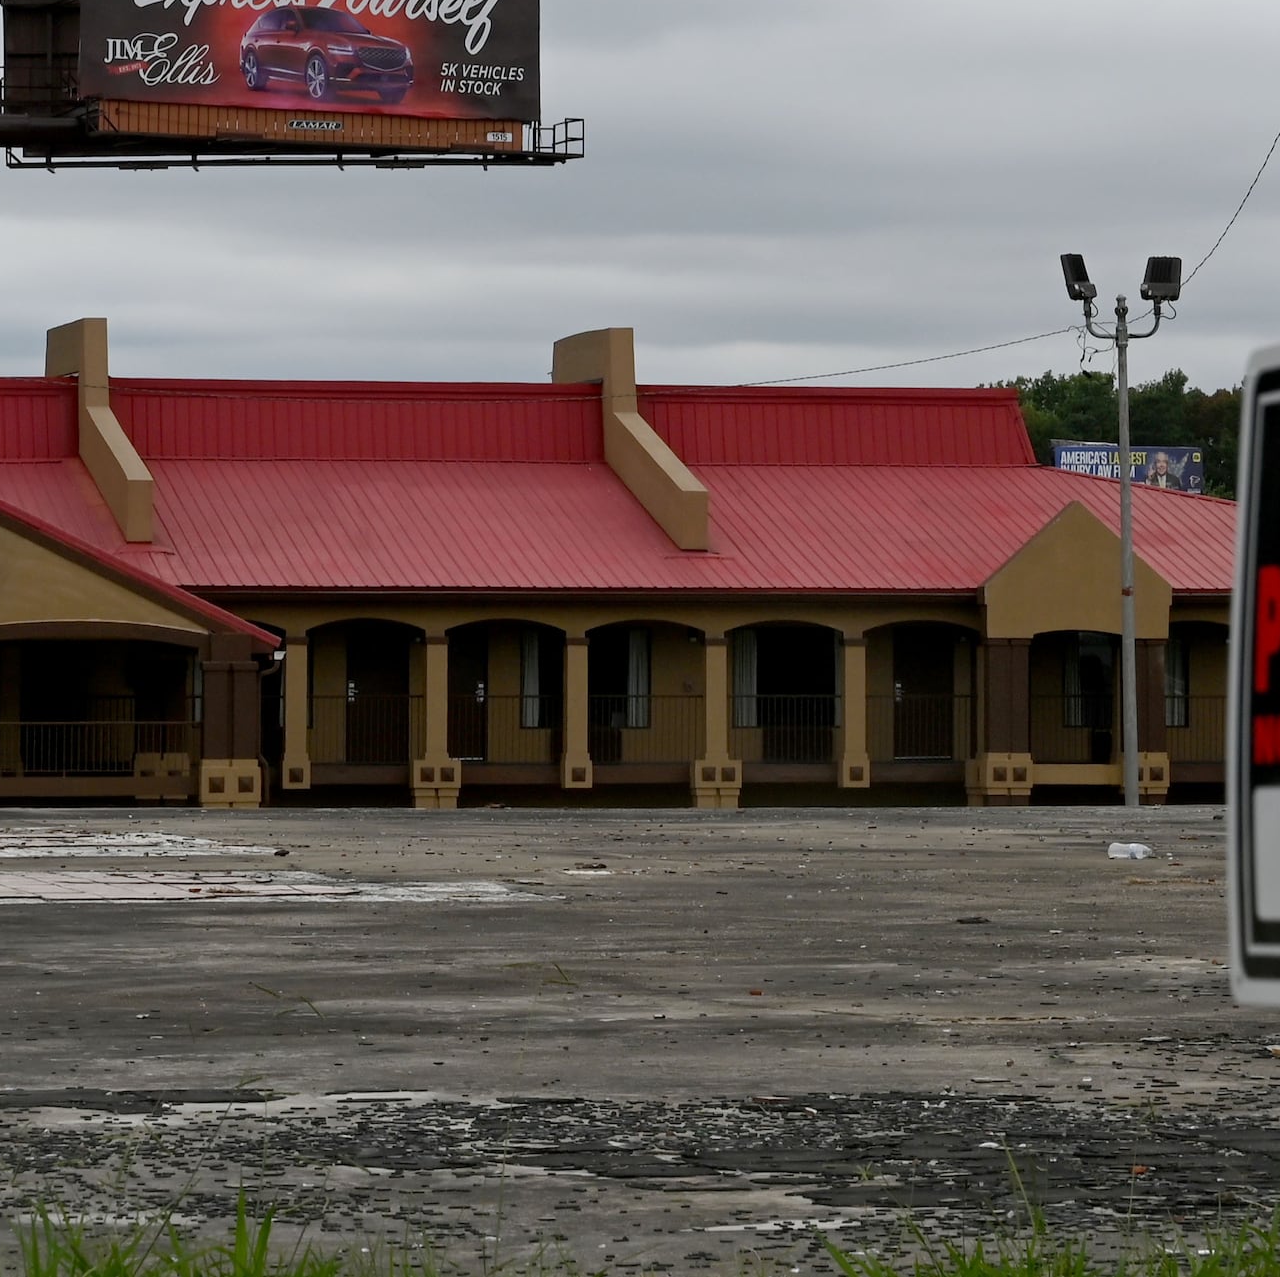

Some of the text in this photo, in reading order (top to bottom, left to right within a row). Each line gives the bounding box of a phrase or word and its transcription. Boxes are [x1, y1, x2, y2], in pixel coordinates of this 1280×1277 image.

[104, 38, 143, 63] JIM
[131, 32, 220, 86] Ellis
[441, 62, 525, 81] 5K VEHICLES
[441, 78, 502, 96] IN STOCK
[292, 121, 337, 130] LAMAR
[491, 133, 508, 141] 1515
[1060, 451, 1147, 464] AMERICA'S LAEST
[1093, 465, 1112, 478] LAW
[1114, 465, 1135, 478] FIM
